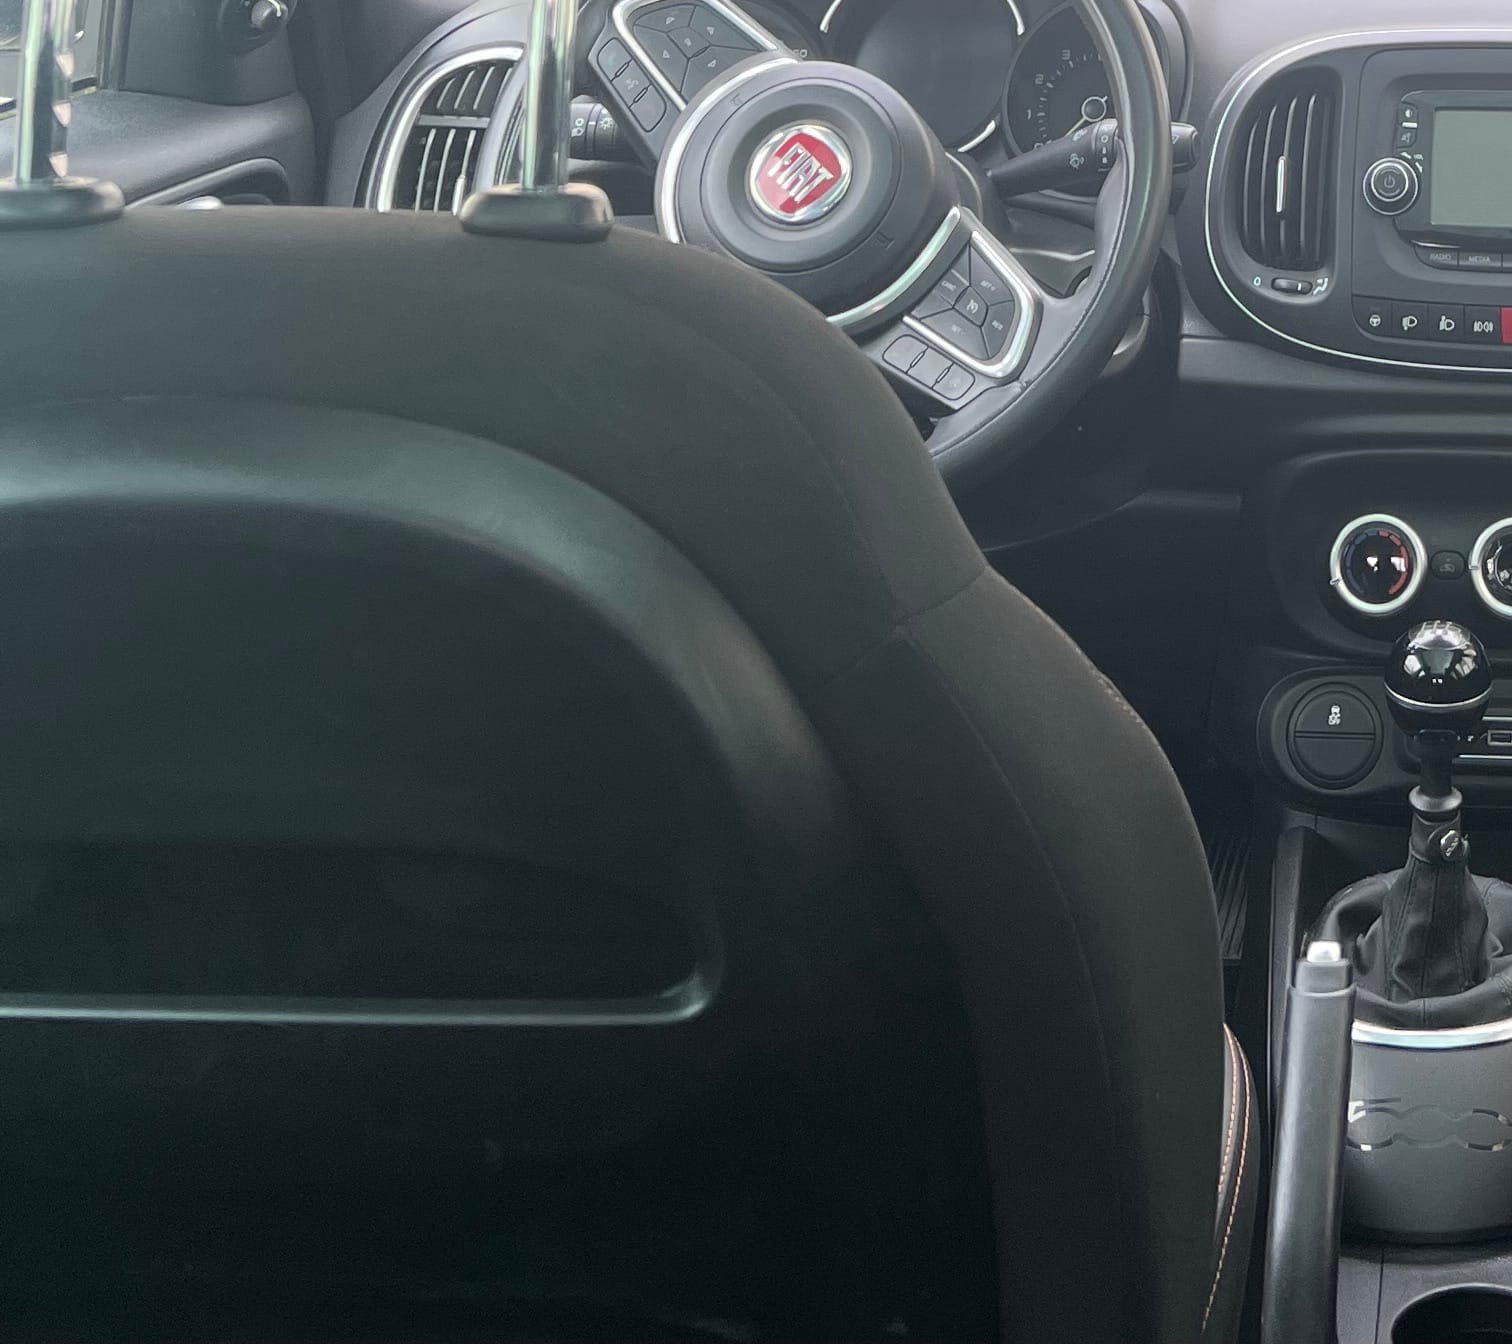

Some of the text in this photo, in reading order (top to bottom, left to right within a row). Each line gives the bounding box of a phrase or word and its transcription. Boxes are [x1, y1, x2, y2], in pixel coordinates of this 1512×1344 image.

[767, 142, 834, 203] FIAT
[1430, 253, 1452, 261] RADIO
[1468, 255, 1490, 263] MEDIA
